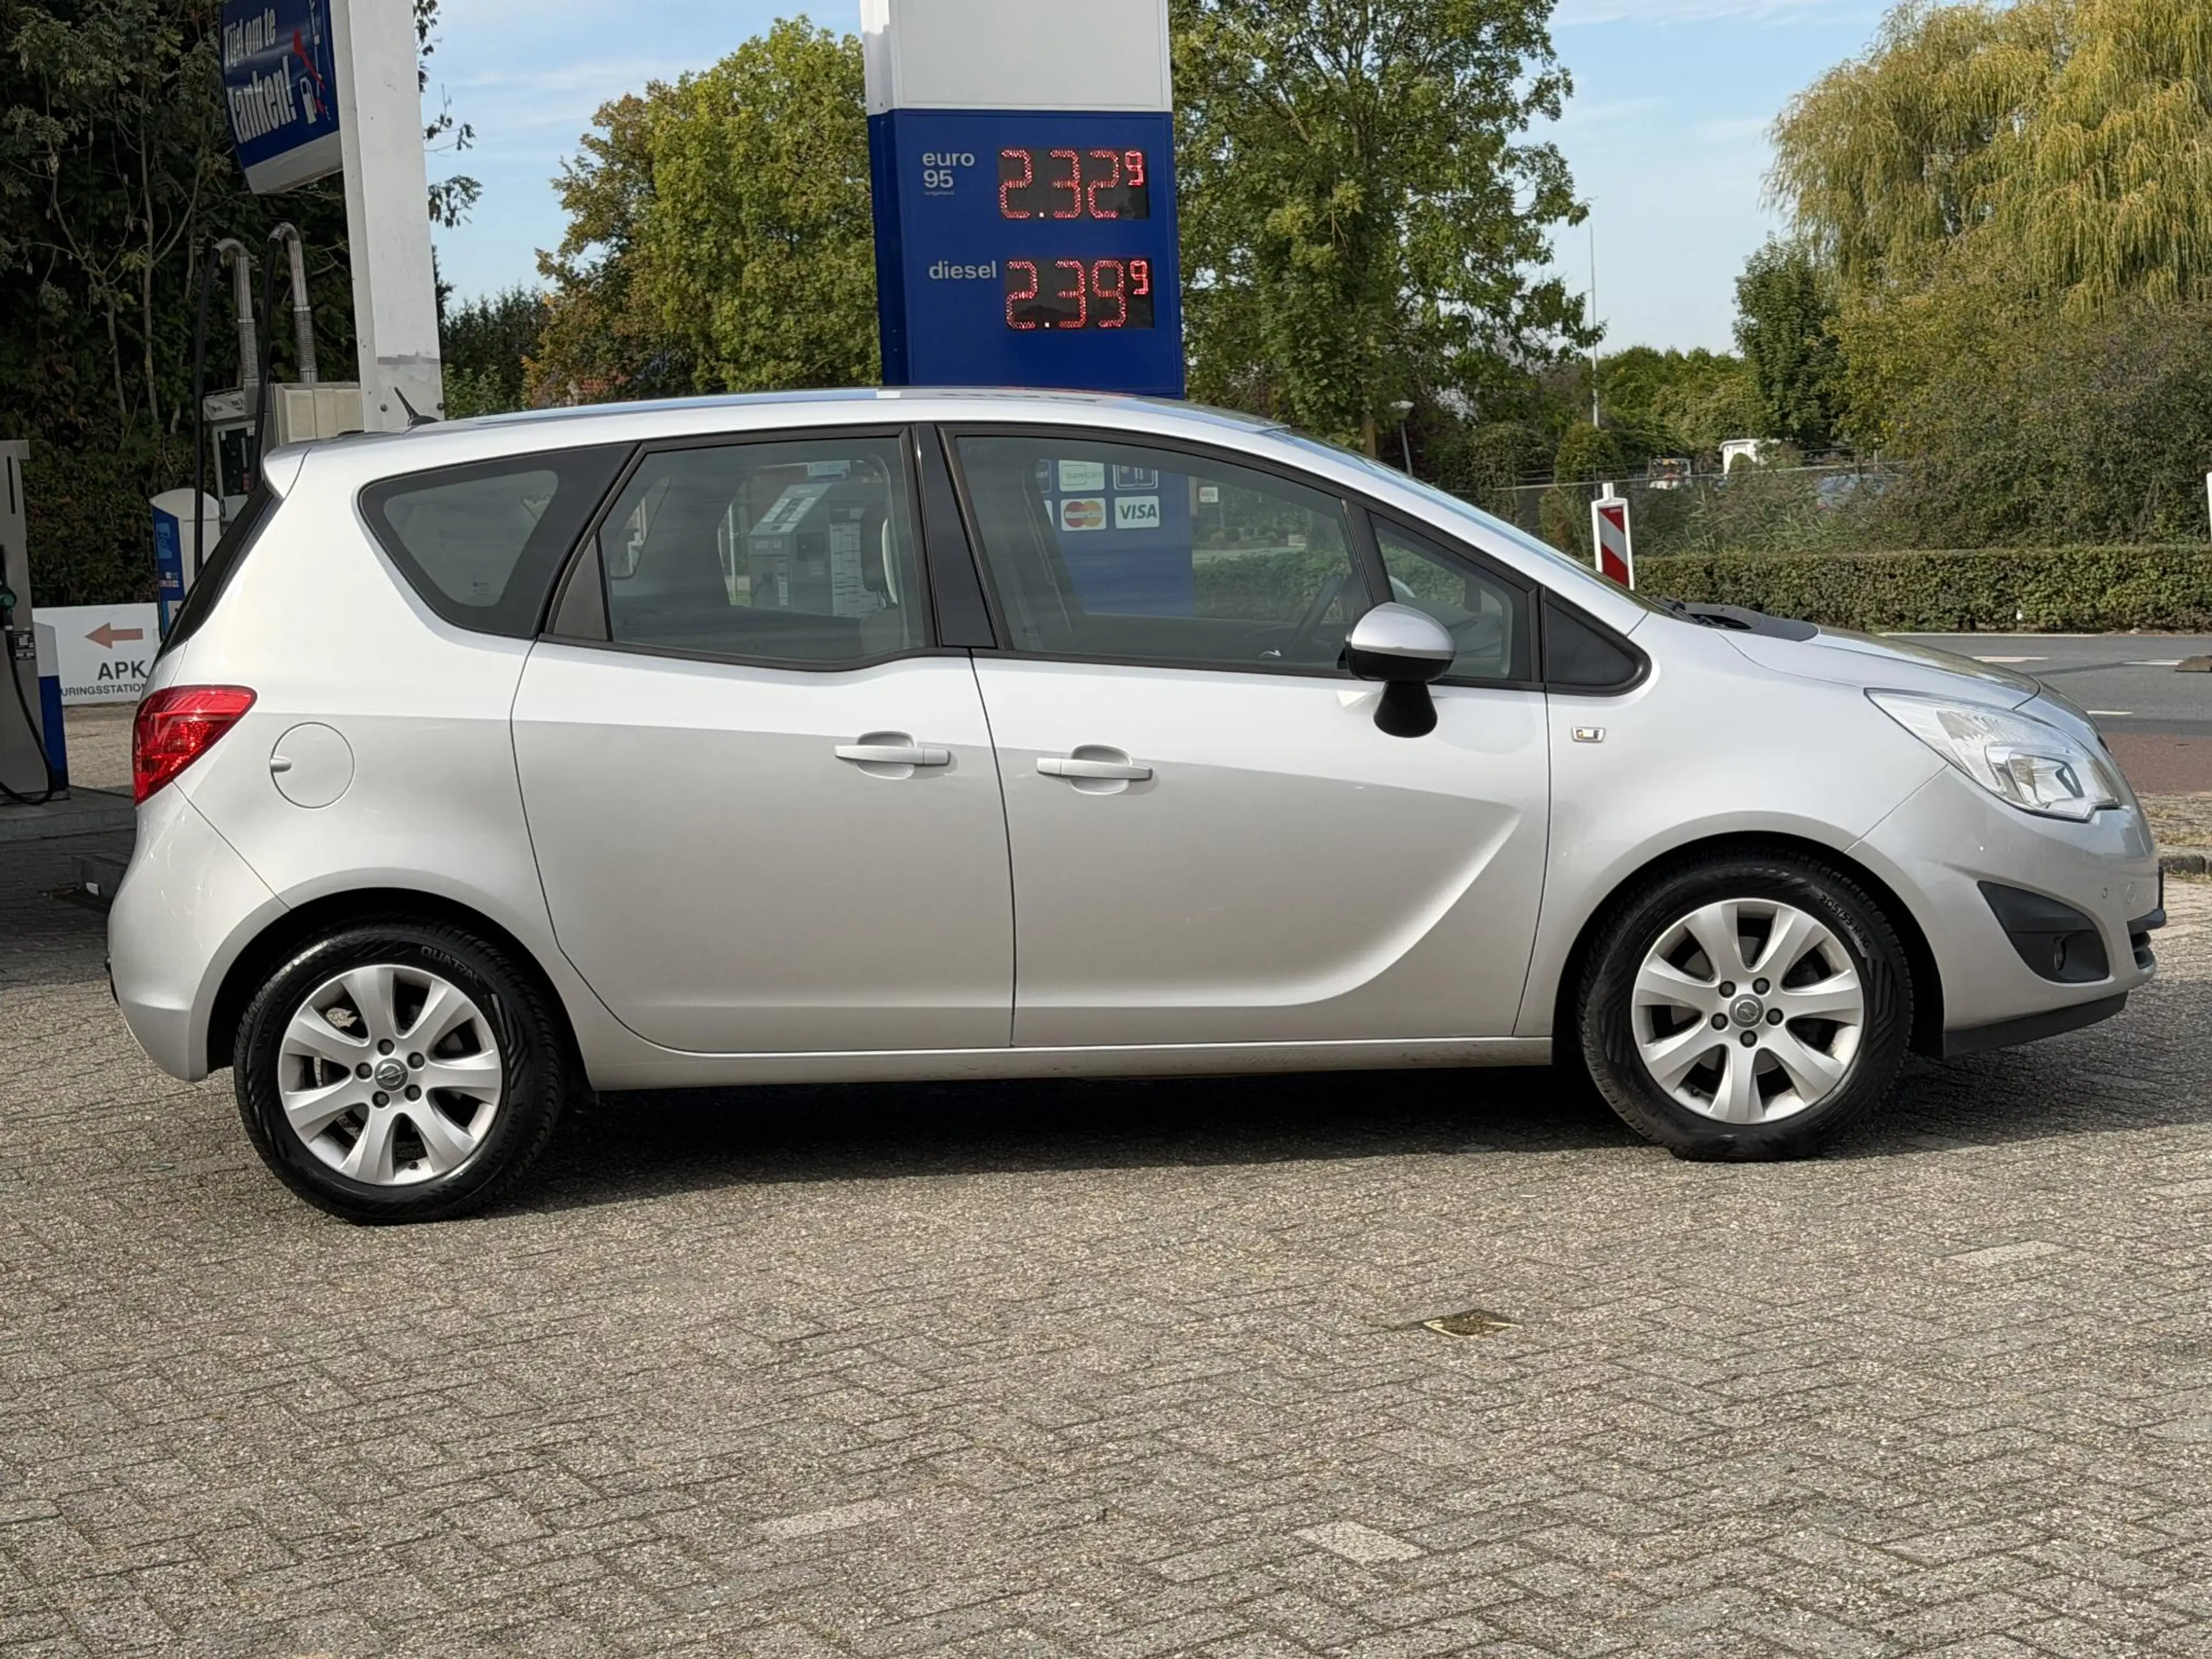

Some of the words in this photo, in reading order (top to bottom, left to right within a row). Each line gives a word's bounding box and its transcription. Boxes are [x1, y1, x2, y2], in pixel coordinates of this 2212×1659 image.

[224, 18, 244, 67] Tijd
[245, 16, 263, 57] om
[263, 7, 276, 47] te
[922, 152, 975, 167] euro
[923, 169, 954, 188] 95
[929, 260, 997, 279] diesel
[1119, 503, 1157, 520] VISA
[97, 660, 147, 681] APK
[421, 945, 484, 988] QUATRAC
